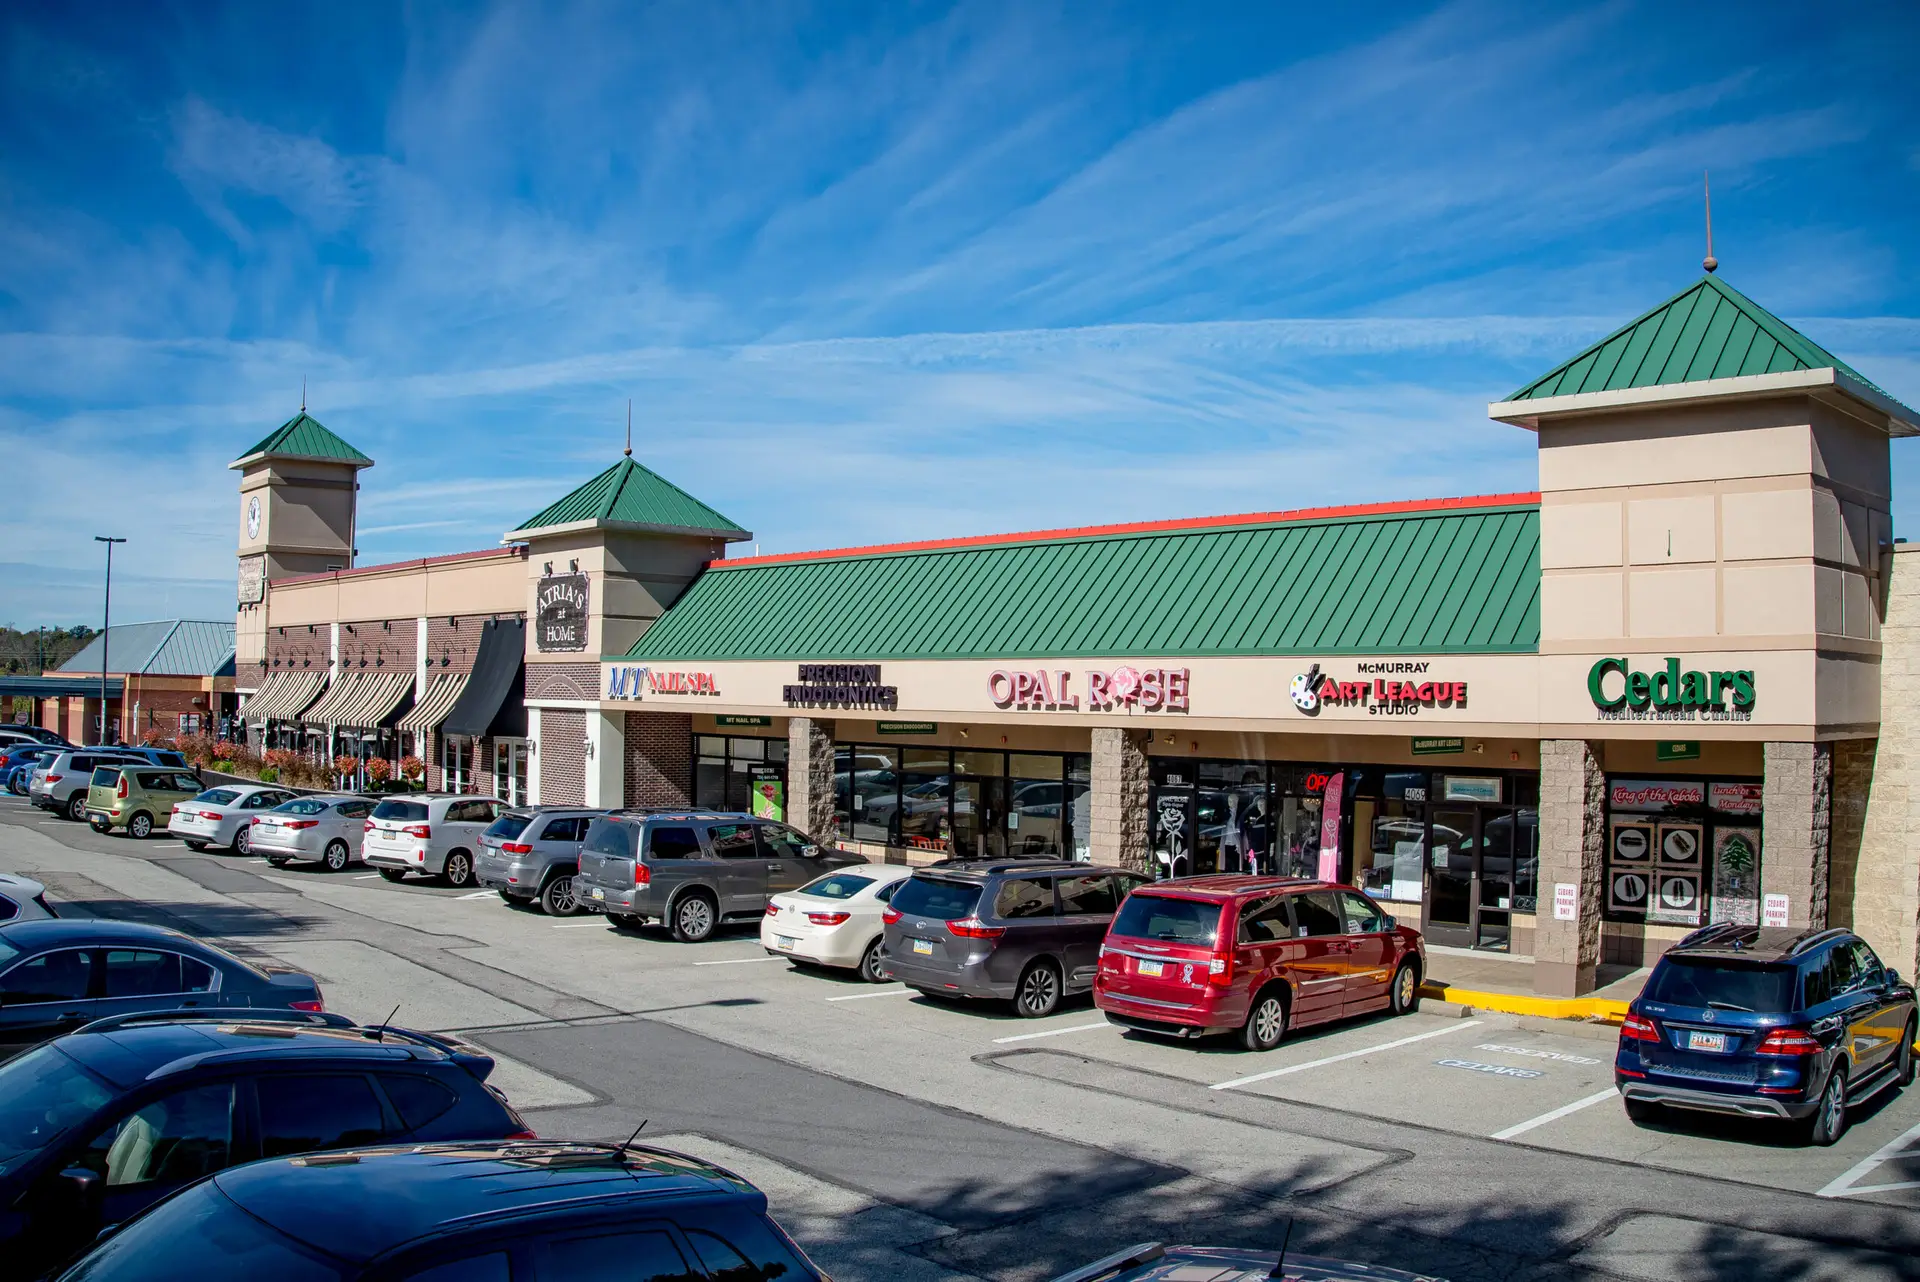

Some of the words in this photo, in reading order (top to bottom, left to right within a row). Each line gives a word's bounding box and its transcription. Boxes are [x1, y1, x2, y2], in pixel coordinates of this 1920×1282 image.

[540, 584, 584, 614] ATRIA'S
[557, 608, 566, 619] at
[547, 626, 575, 641] HOME
[798, 664, 878, 682] PRECISION
[1357, 662, 1430, 673] McMURRAY
[608, 668, 646, 697] MT
[648, 672, 684, 691] NAIL
[687, 673, 717, 692] SPA
[987, 669, 1079, 706] OPAL
[1319, 678, 1369, 700] ART
[1373, 679, 1465, 701] LEAGUE
[1587, 657, 1757, 707] Cedars
[783, 685, 897, 706] ENDODONTICS
[1369, 705, 1418, 715] STUDIO
[1597, 708, 1696, 721] Mediterranean
[1700, 709, 1752, 721] Cuisine
[1306, 773, 1329, 791] OP
[1405, 788, 1425, 801] 4069
[1612, 787, 1636, 803] King
[1637, 789, 1649, 803] of
[1650, 788, 1667, 801] the
[1667, 790, 1701, 805] Kabobs
[1719, 800, 1754, 811] Monday
[1767, 899, 1785, 908] CEDARS
[1766, 911, 1785, 919] PARKING
[1473, 1044, 1602, 1065] RESERVED
[1438, 1059, 1541, 1078] CEDARS
